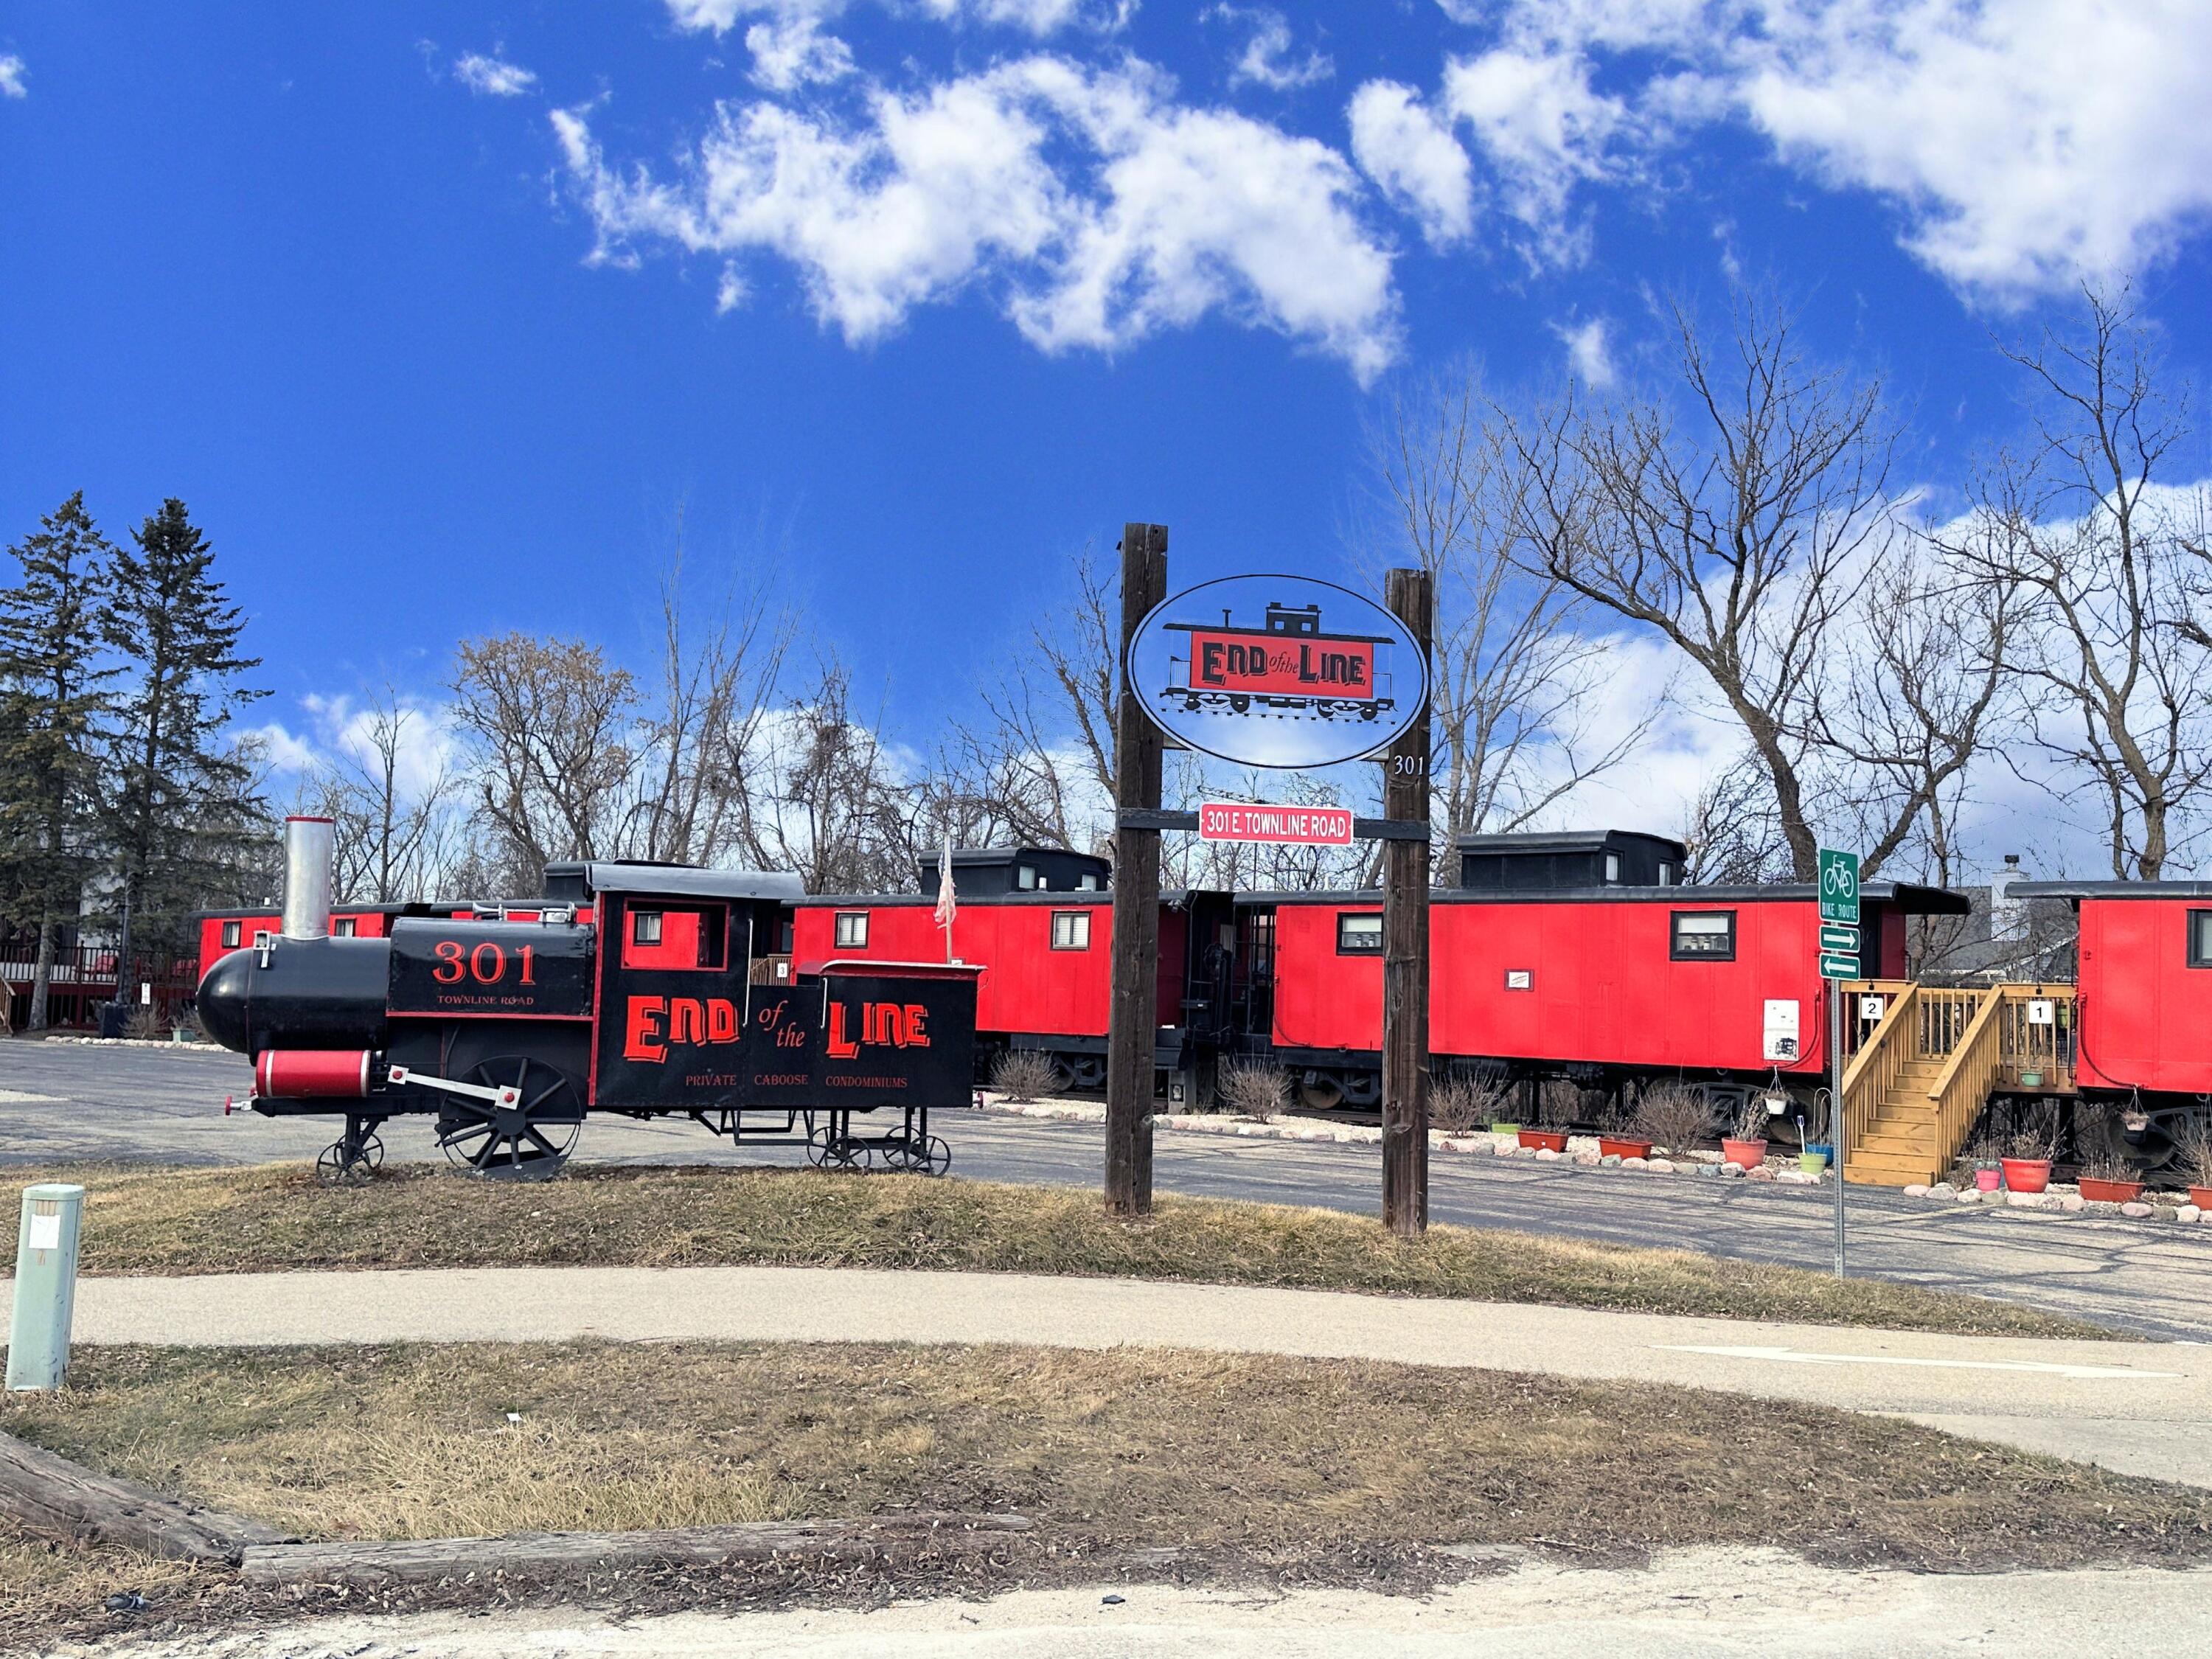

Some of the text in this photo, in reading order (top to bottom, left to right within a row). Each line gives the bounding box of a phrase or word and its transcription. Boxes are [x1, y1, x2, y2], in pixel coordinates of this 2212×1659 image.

[1269, 651, 1287, 672] of
[1279, 655, 1298, 674] the
[1394, 755, 1423, 775] 301
[1207, 810, 1346, 838] 301 E. TOWNLINE ROAD
[1822, 902, 1857, 919] BIKE ROUTE
[432, 941, 536, 985] 301
[780, 966, 785, 975] 3
[437, 995, 534, 1005] TOWNLINE ROAD
[1868, 1003, 1877, 1014] 2
[2036, 1006, 2042, 1018] 1
[758, 1000, 788, 1031] of
[776, 1021, 805, 1047] the
[686, 1074, 908, 1088] PRIVATE CABOOSE CONDOMINIUMS
